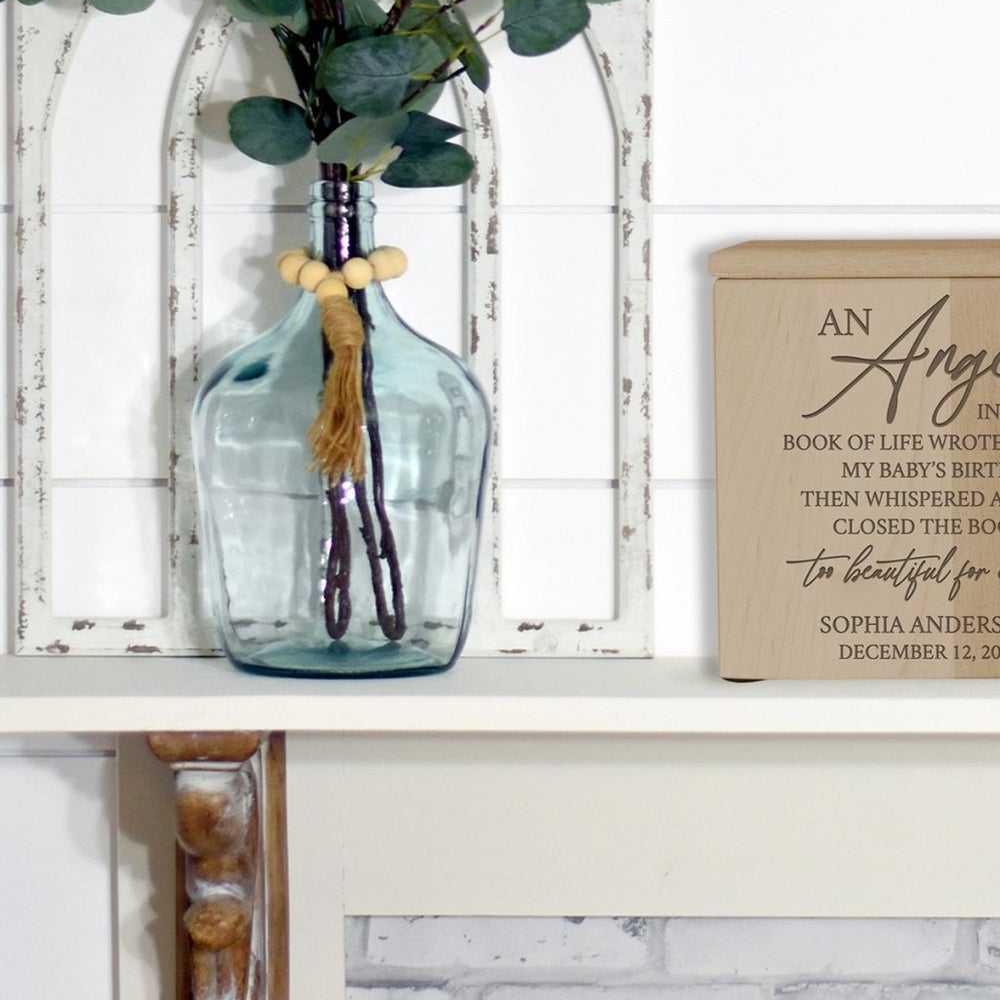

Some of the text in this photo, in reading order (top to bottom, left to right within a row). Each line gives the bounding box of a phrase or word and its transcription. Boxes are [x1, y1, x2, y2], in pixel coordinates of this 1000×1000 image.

[817, 308, 872, 336] AN
[976, 403, 1000, 420] IN
[782, 434, 843, 451] BOOK
[847, 434, 875, 451] OF
[880, 434, 924, 451] LIFE
[841, 462, 875, 479] MY
[801, 490, 860, 508] THEN
[865, 490, 985, 508] WHISPERED
[833, 518, 915, 535] CLOSED
[920, 518, 963, 535] THE
[786, 548, 850, 587] too
[844, 544, 958, 601] beautiful
[947, 557, 990, 601] for
[820, 615, 904, 635] SOPHIA
[838, 644, 949, 660] DECEMBER
[953, 644, 976, 662] 12,
